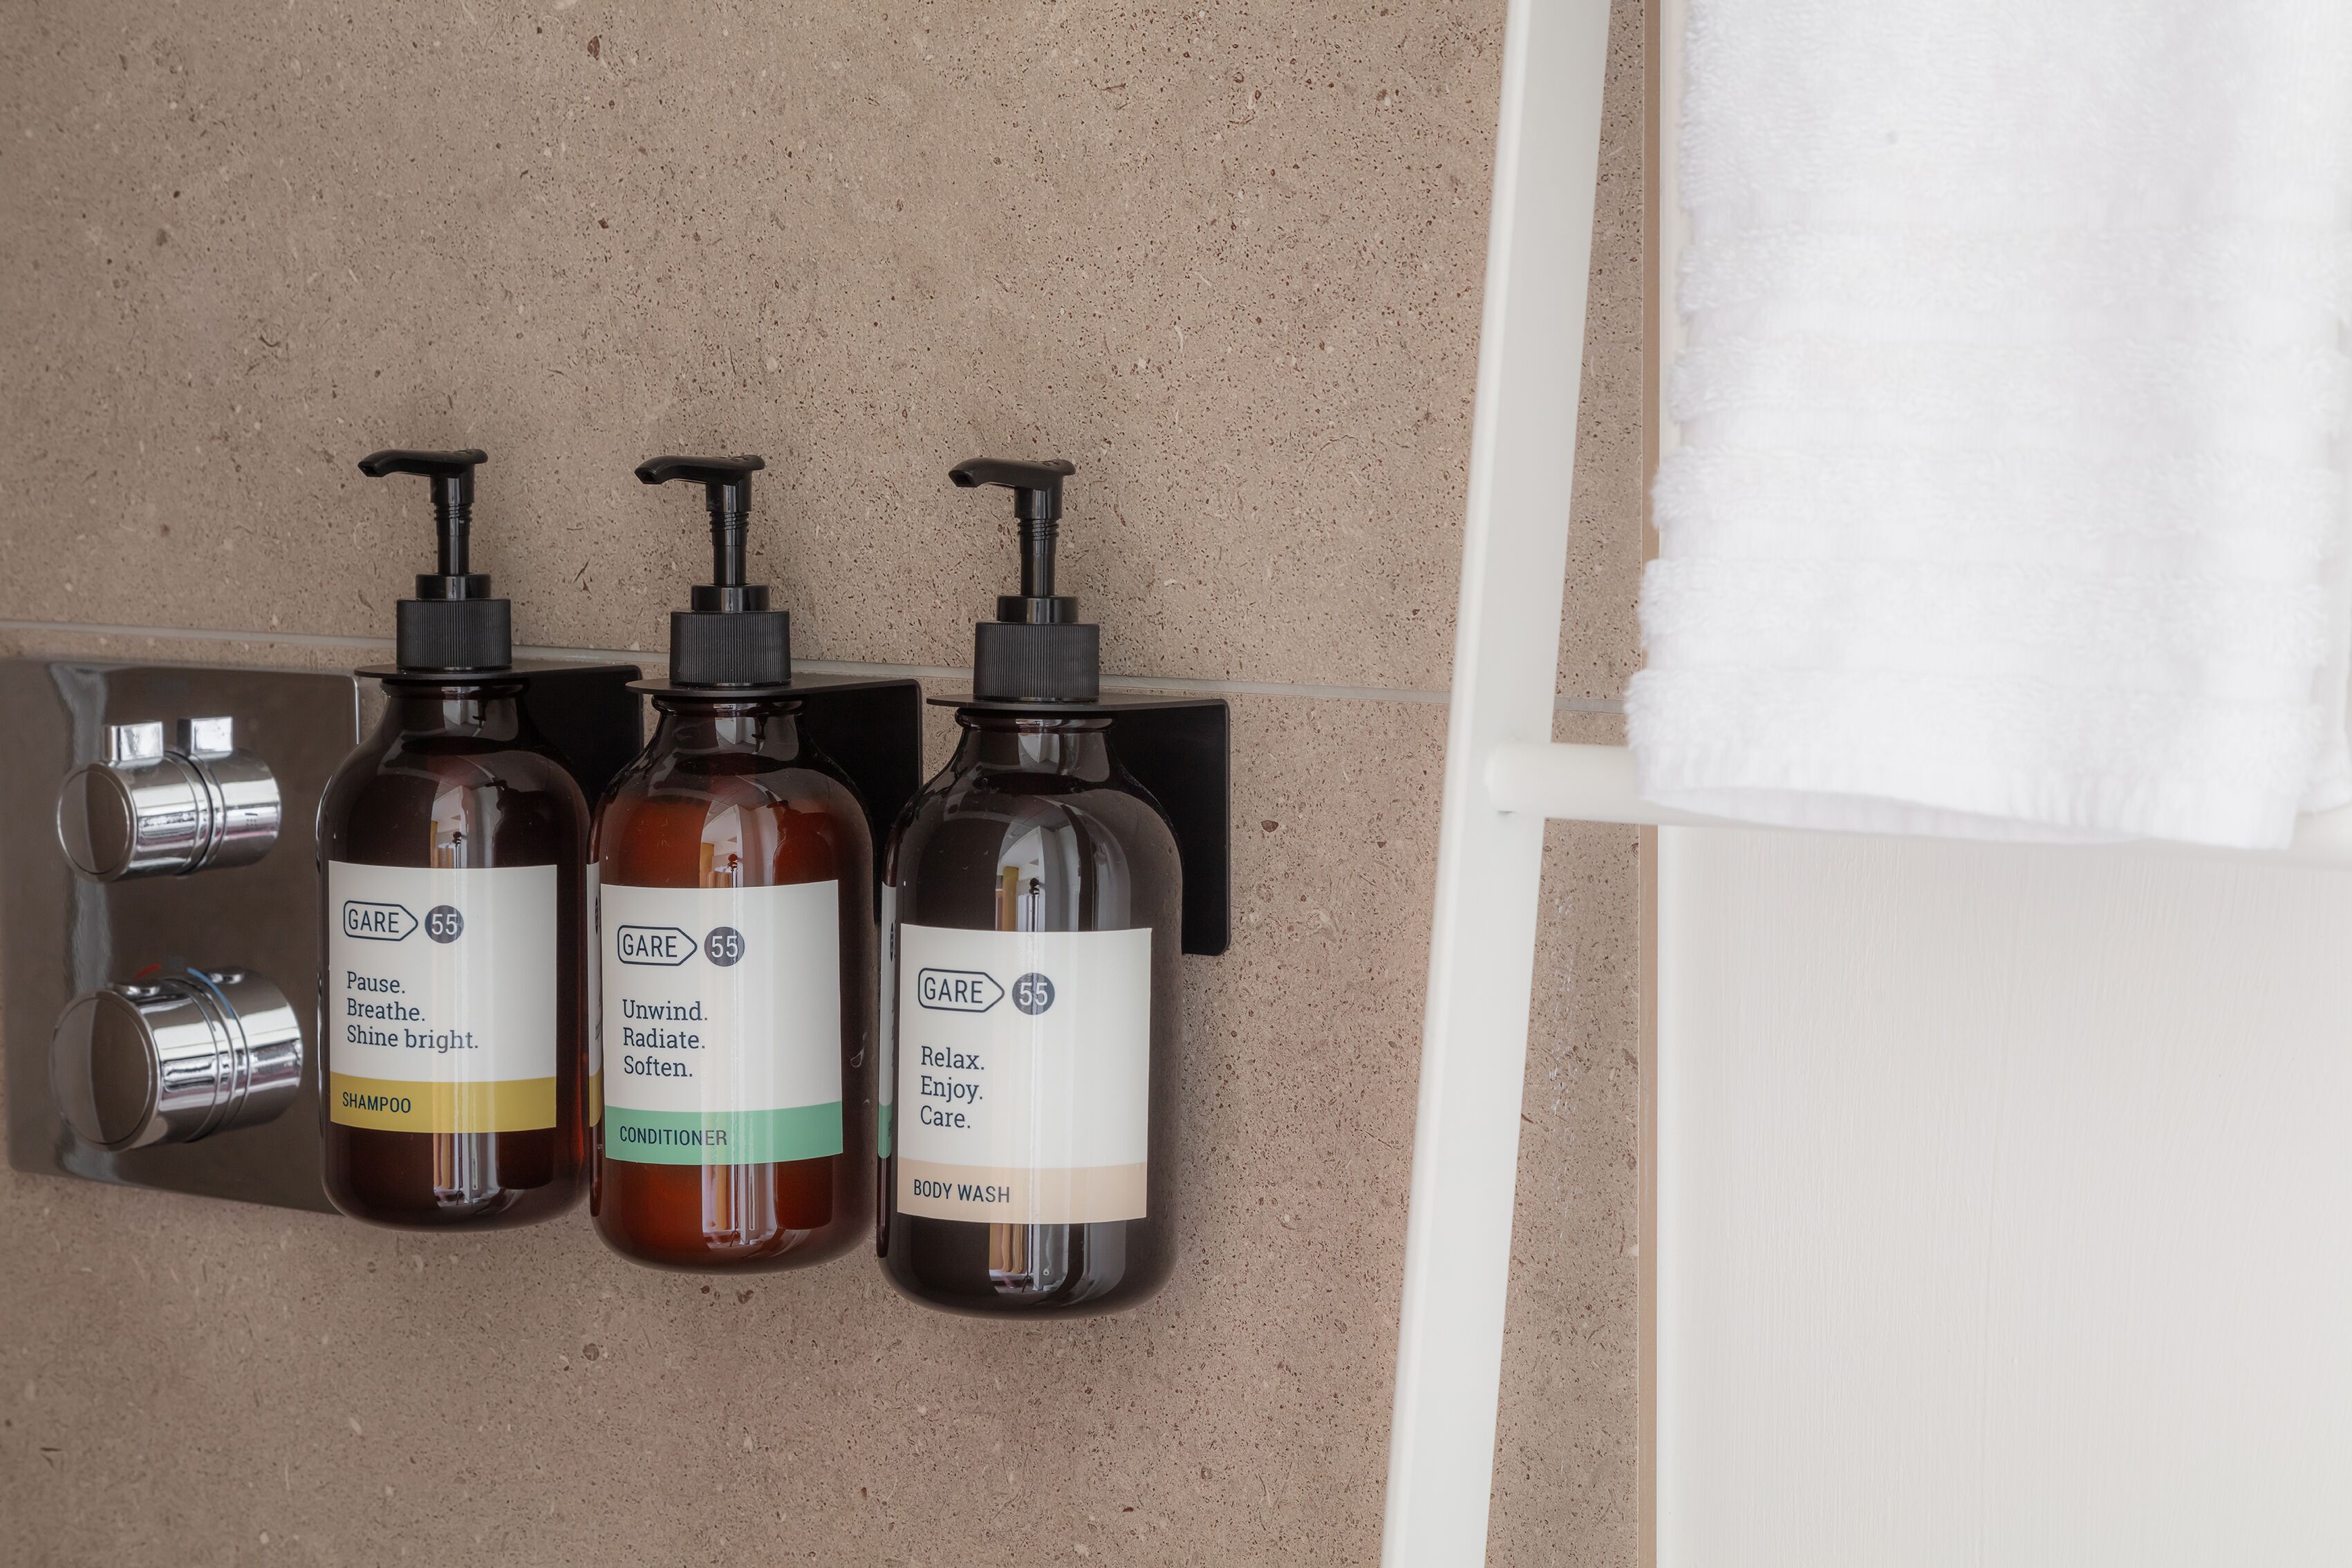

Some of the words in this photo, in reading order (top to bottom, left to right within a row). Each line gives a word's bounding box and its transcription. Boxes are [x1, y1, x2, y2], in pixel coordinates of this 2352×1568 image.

[348, 910, 400, 933] GARE
[431, 913, 458, 935] 55
[622, 933, 678, 958] GARE
[711, 935, 738, 958] 55
[346, 971, 406, 994] Pause.
[924, 977, 983, 1004] GARE
[1019, 982, 1048, 1006] 55
[346, 998, 425, 1022] Breathe.
[622, 999, 708, 1021] Unwind.
[346, 1025, 399, 1047] Shine
[404, 1029, 479, 1054] bright.
[623, 1027, 706, 1049] Radiate.
[624, 1056, 693, 1078] Soften.
[921, 1046, 984, 1071] Relax.
[920, 1076, 983, 1104] Enjoy.
[342, 1091, 411, 1114] SHAMPOO
[920, 1105, 971, 1129] Care.
[619, 1126, 727, 1146] CONDITIONER
[913, 1179, 953, 1200] BODY
[958, 1184, 1010, 1204] WASH
